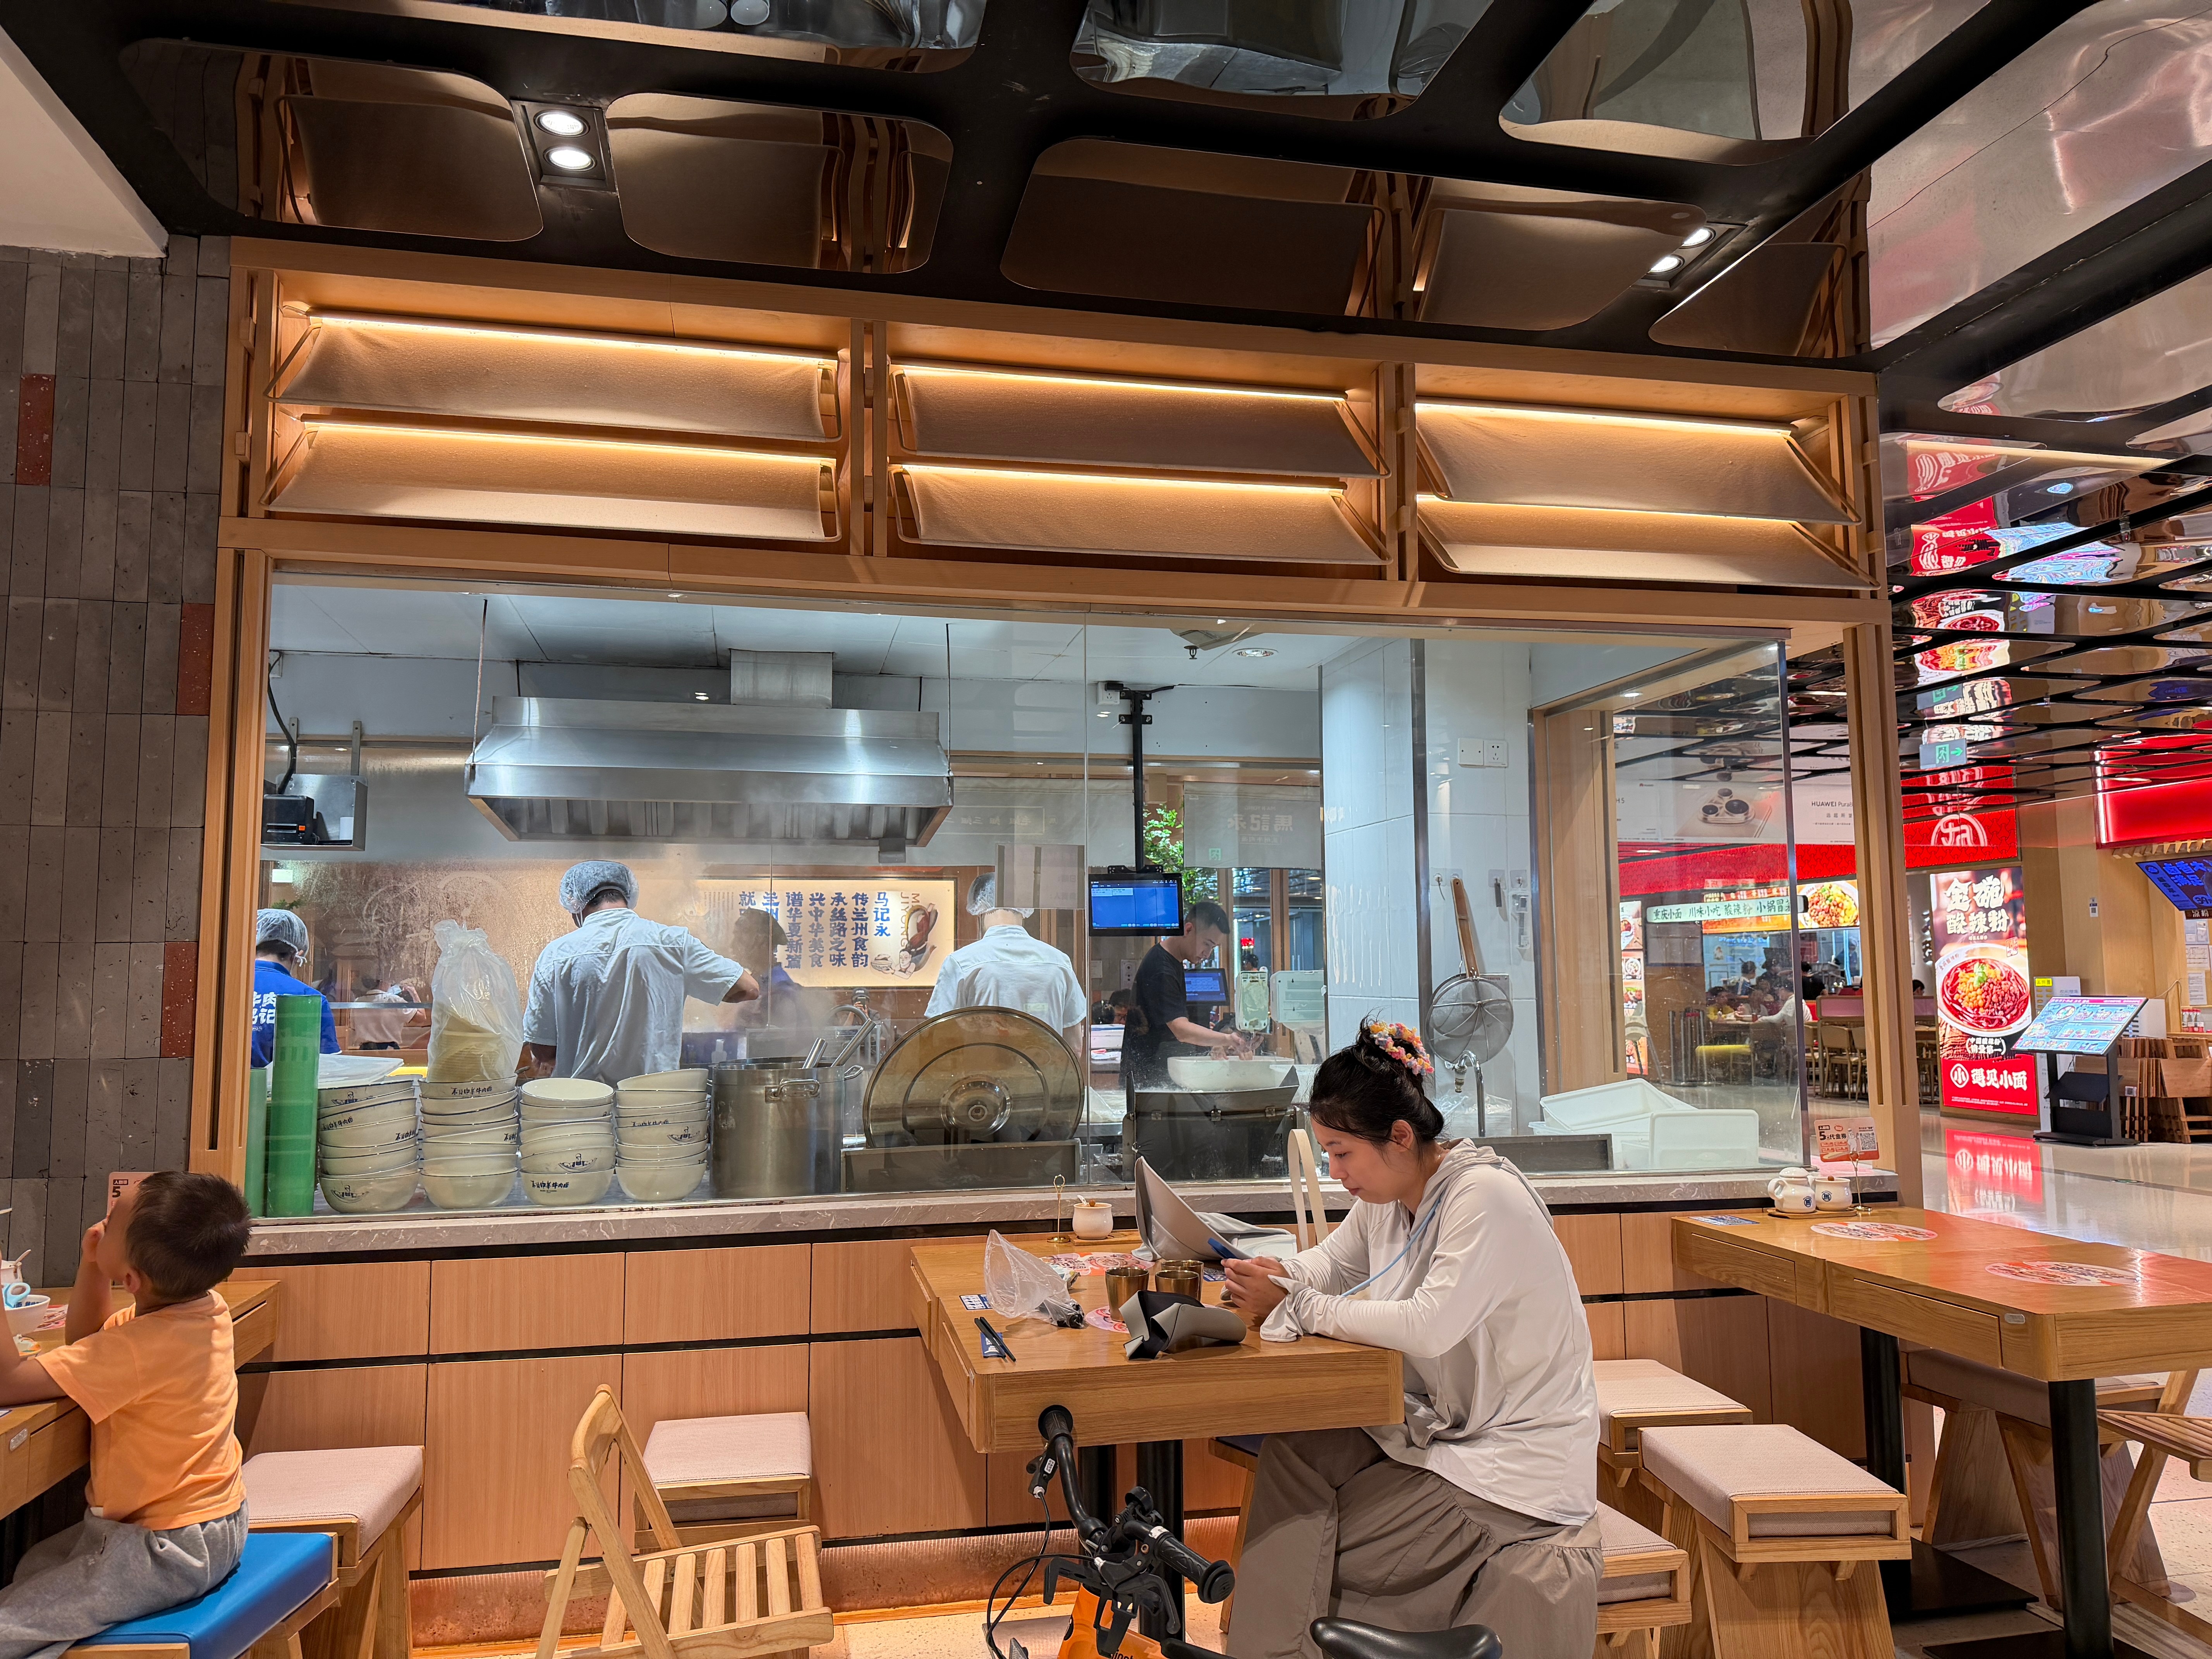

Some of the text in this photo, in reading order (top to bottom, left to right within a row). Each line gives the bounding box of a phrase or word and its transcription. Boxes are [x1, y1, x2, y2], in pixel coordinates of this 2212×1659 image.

[785, 891, 804, 969] 谱华夏新篇
[808, 892, 826, 967] 兴中华美食
[829, 892, 847, 967] 承丝路之味
[851, 892, 869, 968] 传兰州食韵
[873, 891, 891, 937] 马记永
[1653, 908, 1682, 920] 重庆小面
[1688, 905, 1721, 918] 川味小吃
[1724, 902, 1753, 916] 酸辣粉
[1946, 908, 2009, 934] 酸辣粉
[1971, 1068, 2028, 1091] 遇见小面
[112, 1186, 121, 1198] 5
